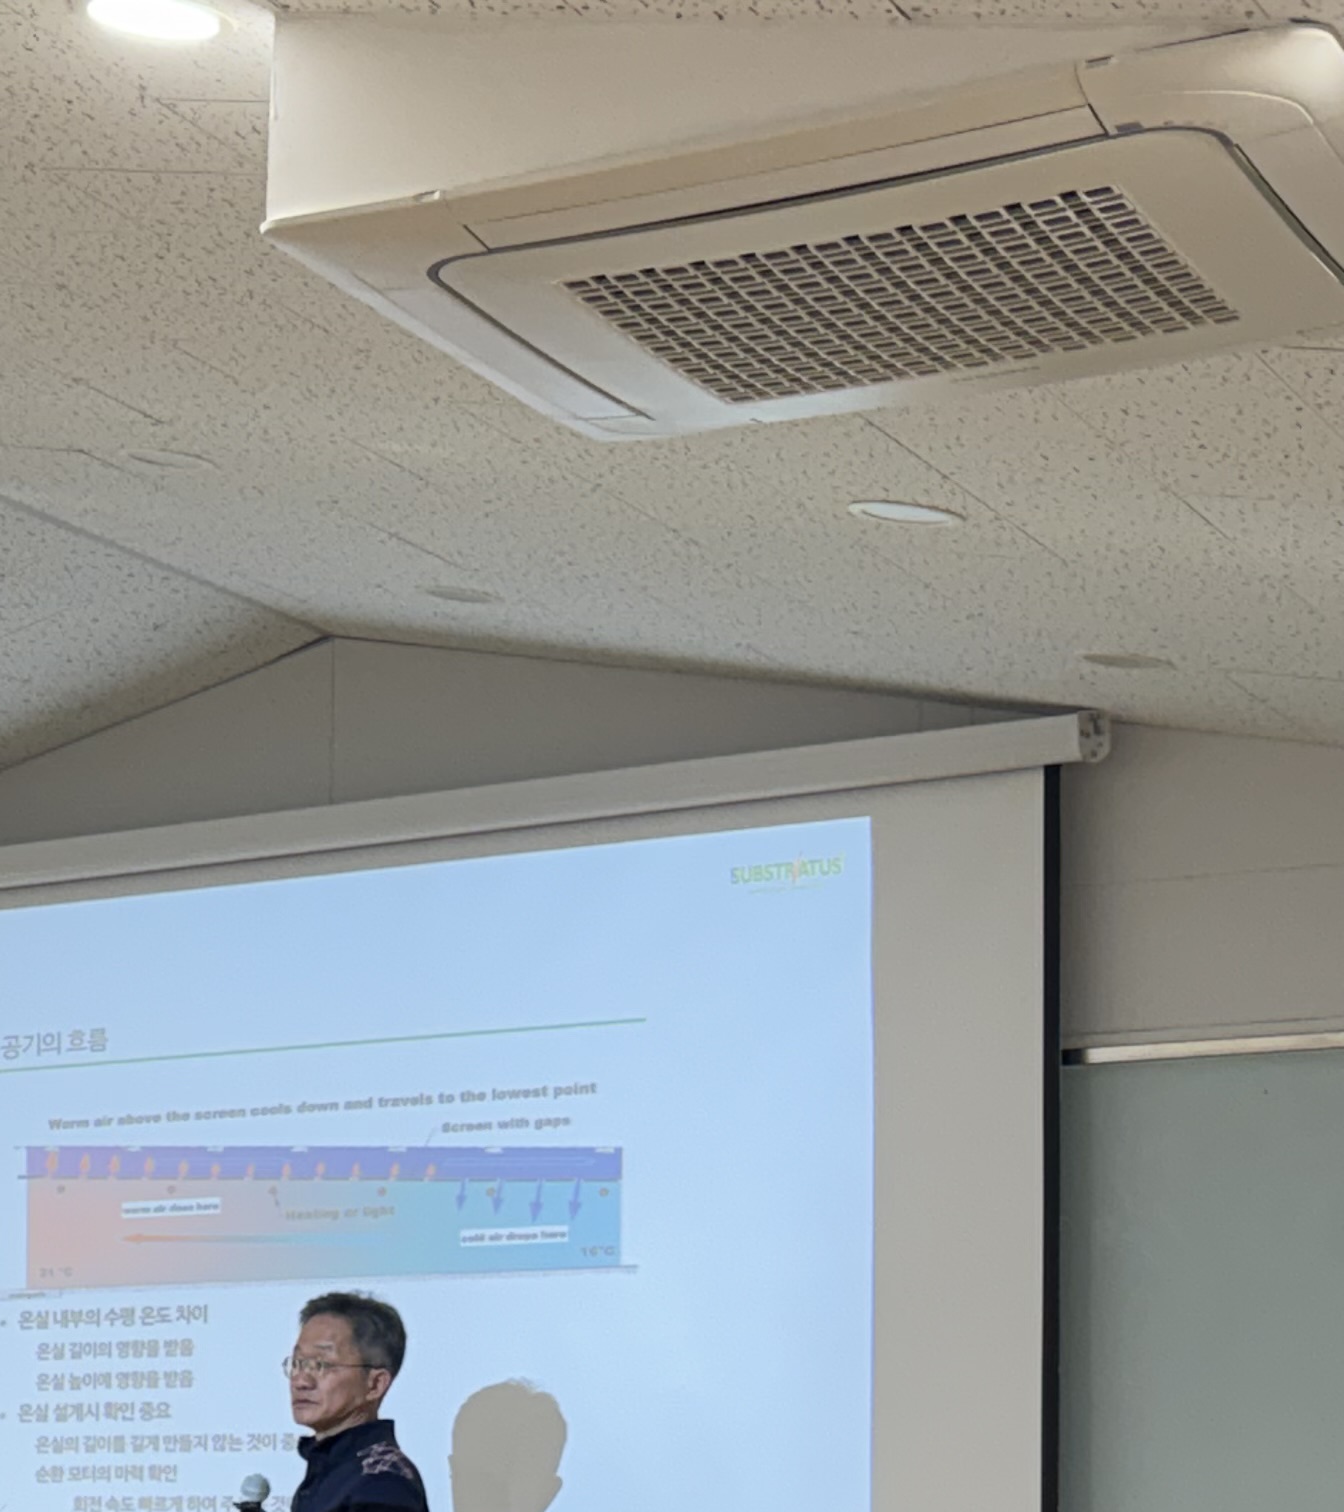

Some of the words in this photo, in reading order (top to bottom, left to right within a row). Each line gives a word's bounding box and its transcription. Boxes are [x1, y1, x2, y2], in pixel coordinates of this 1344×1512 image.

[0, 1031, 61, 1060] 공기의
[67, 1027, 109, 1053] 흐름
[48, 1117, 90, 1130] Warm
[94, 1115, 113, 1127] air
[117, 1112, 162, 1126] above
[166, 1110, 190, 1122] the
[194, 1107, 246, 1119] screen
[297, 1100, 339, 1113] down
[344, 1096, 374, 1110] and
[378, 1092, 433, 1108] travels
[438, 1092, 455, 1105] to
[460, 1089, 487, 1103] the
[491, 1083, 548, 1101] lowest
[553, 1081, 597, 1100] point
[497, 1117, 530, 1130] with
[534, 1115, 571, 1131] gaps
[18, 1310, 50, 1330] 온실
[53, 1307, 102, 1329] 내부의
[104, 1305, 136, 1327] 수평
[139, 1304, 173, 1326] 온도
[176, 1303, 208, 1325] 차이
[36, 1342, 66, 1360] 온실
[69, 1340, 113, 1360] 길이의
[116, 1339, 160, 1359] 영향을
[163, 1337, 194, 1357] 받음
[36, 1372, 66, 1391] 온실
[116, 1370, 160, 1390] 영향을
[163, 1369, 194, 1389] 받음
[18, 1404, 49, 1423] 온실
[53, 1402, 101, 1423] 설계시
[103, 1401, 135, 1421] 확인
[138, 1401, 172, 1420] 중요
[35, 1435, 80, 1455] 온실의
[82, 1434, 127, 1454] 길이를
[130, 1434, 160, 1453] 길게
[162, 1433, 209, 1452] 만들지
[211, 1432, 243, 1452] 않는
[246, 1432, 278, 1451] 것이
[34, 1464, 65, 1483] 순환
[67, 1464, 112, 1483] 모터의
[148, 1463, 178, 1482] 확인
[105, 1495, 136, 1512] 속도
[138, 1495, 184, 1512] 빠르게
[186, 1494, 217, 1512] 하여
